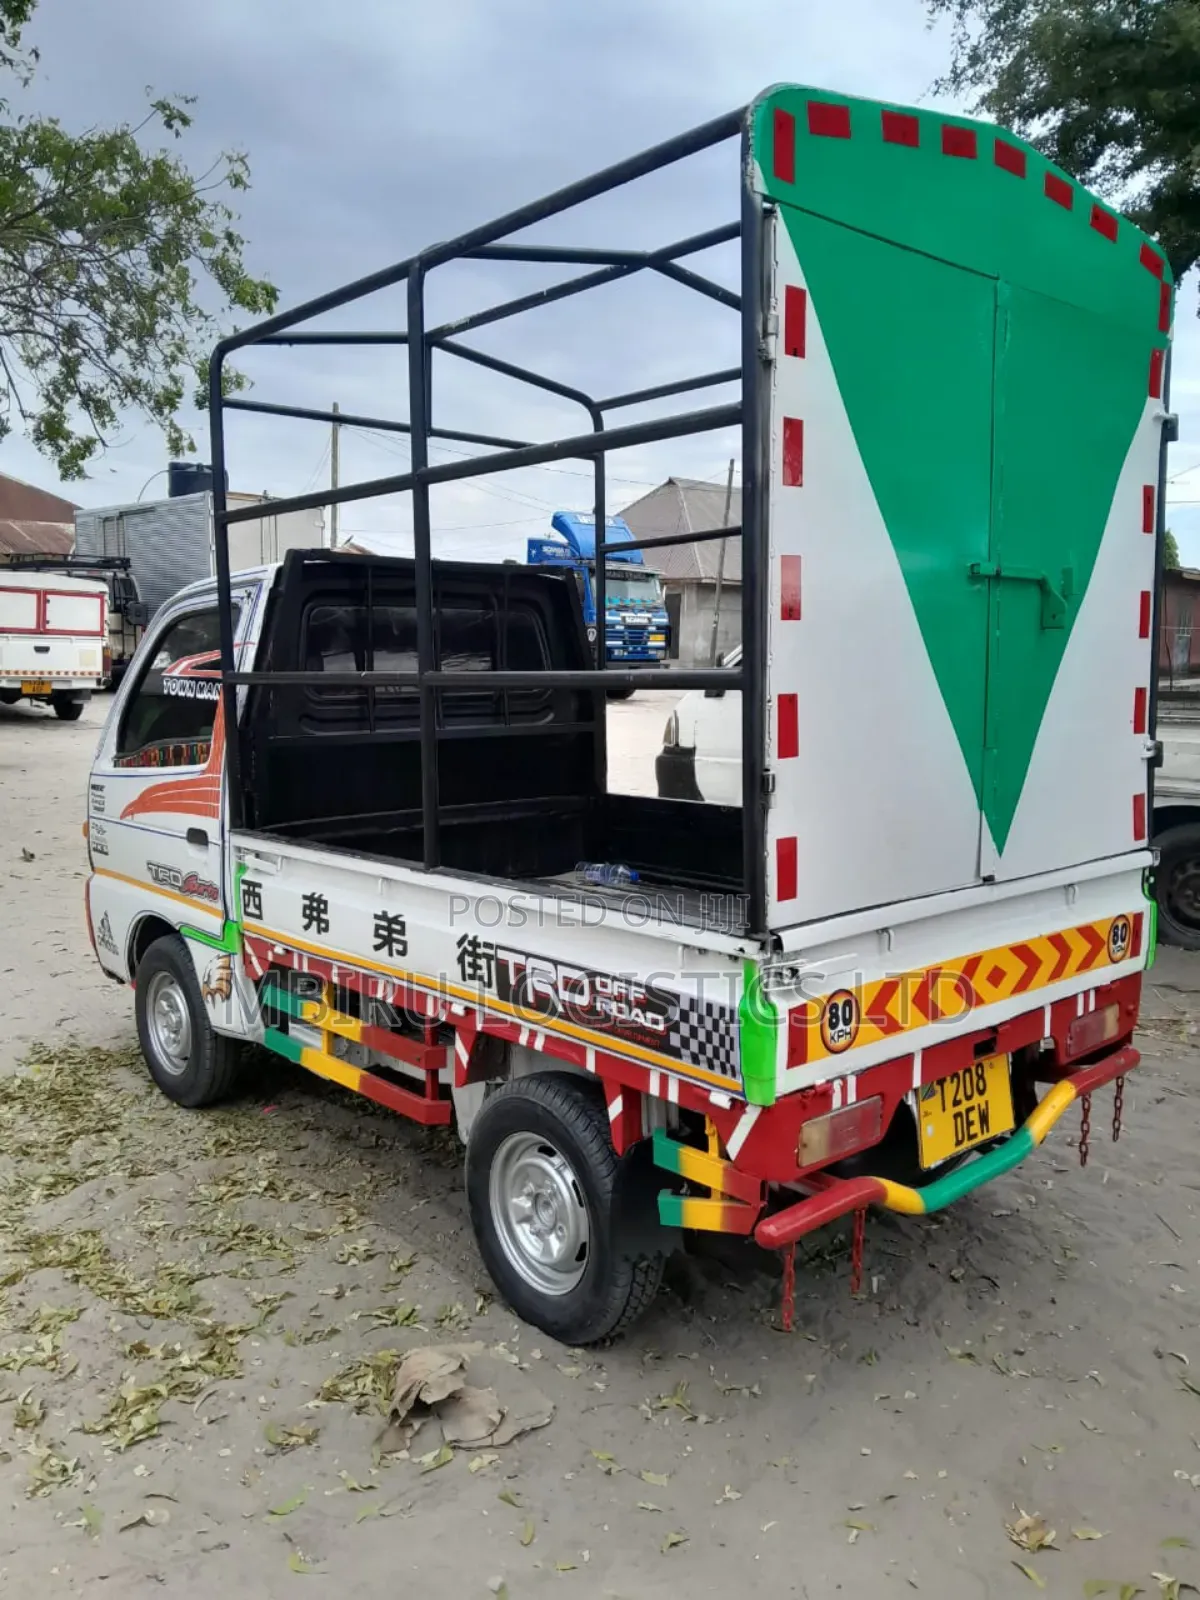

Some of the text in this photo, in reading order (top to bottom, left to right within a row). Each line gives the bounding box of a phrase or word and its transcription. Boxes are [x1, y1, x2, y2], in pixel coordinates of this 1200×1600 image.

[163, 677, 196, 698] TOWN
[1112, 922, 1127, 945] 80
[496, 948, 591, 1012] TRD
[595, 976, 647, 1001] OFF
[596, 999, 665, 1032] ROAD
[828, 998, 853, 1031] 80
[829, 1027, 852, 1044] KPH
[936, 1062, 987, 1113] T208
[952, 1100, 990, 1148] DEW
